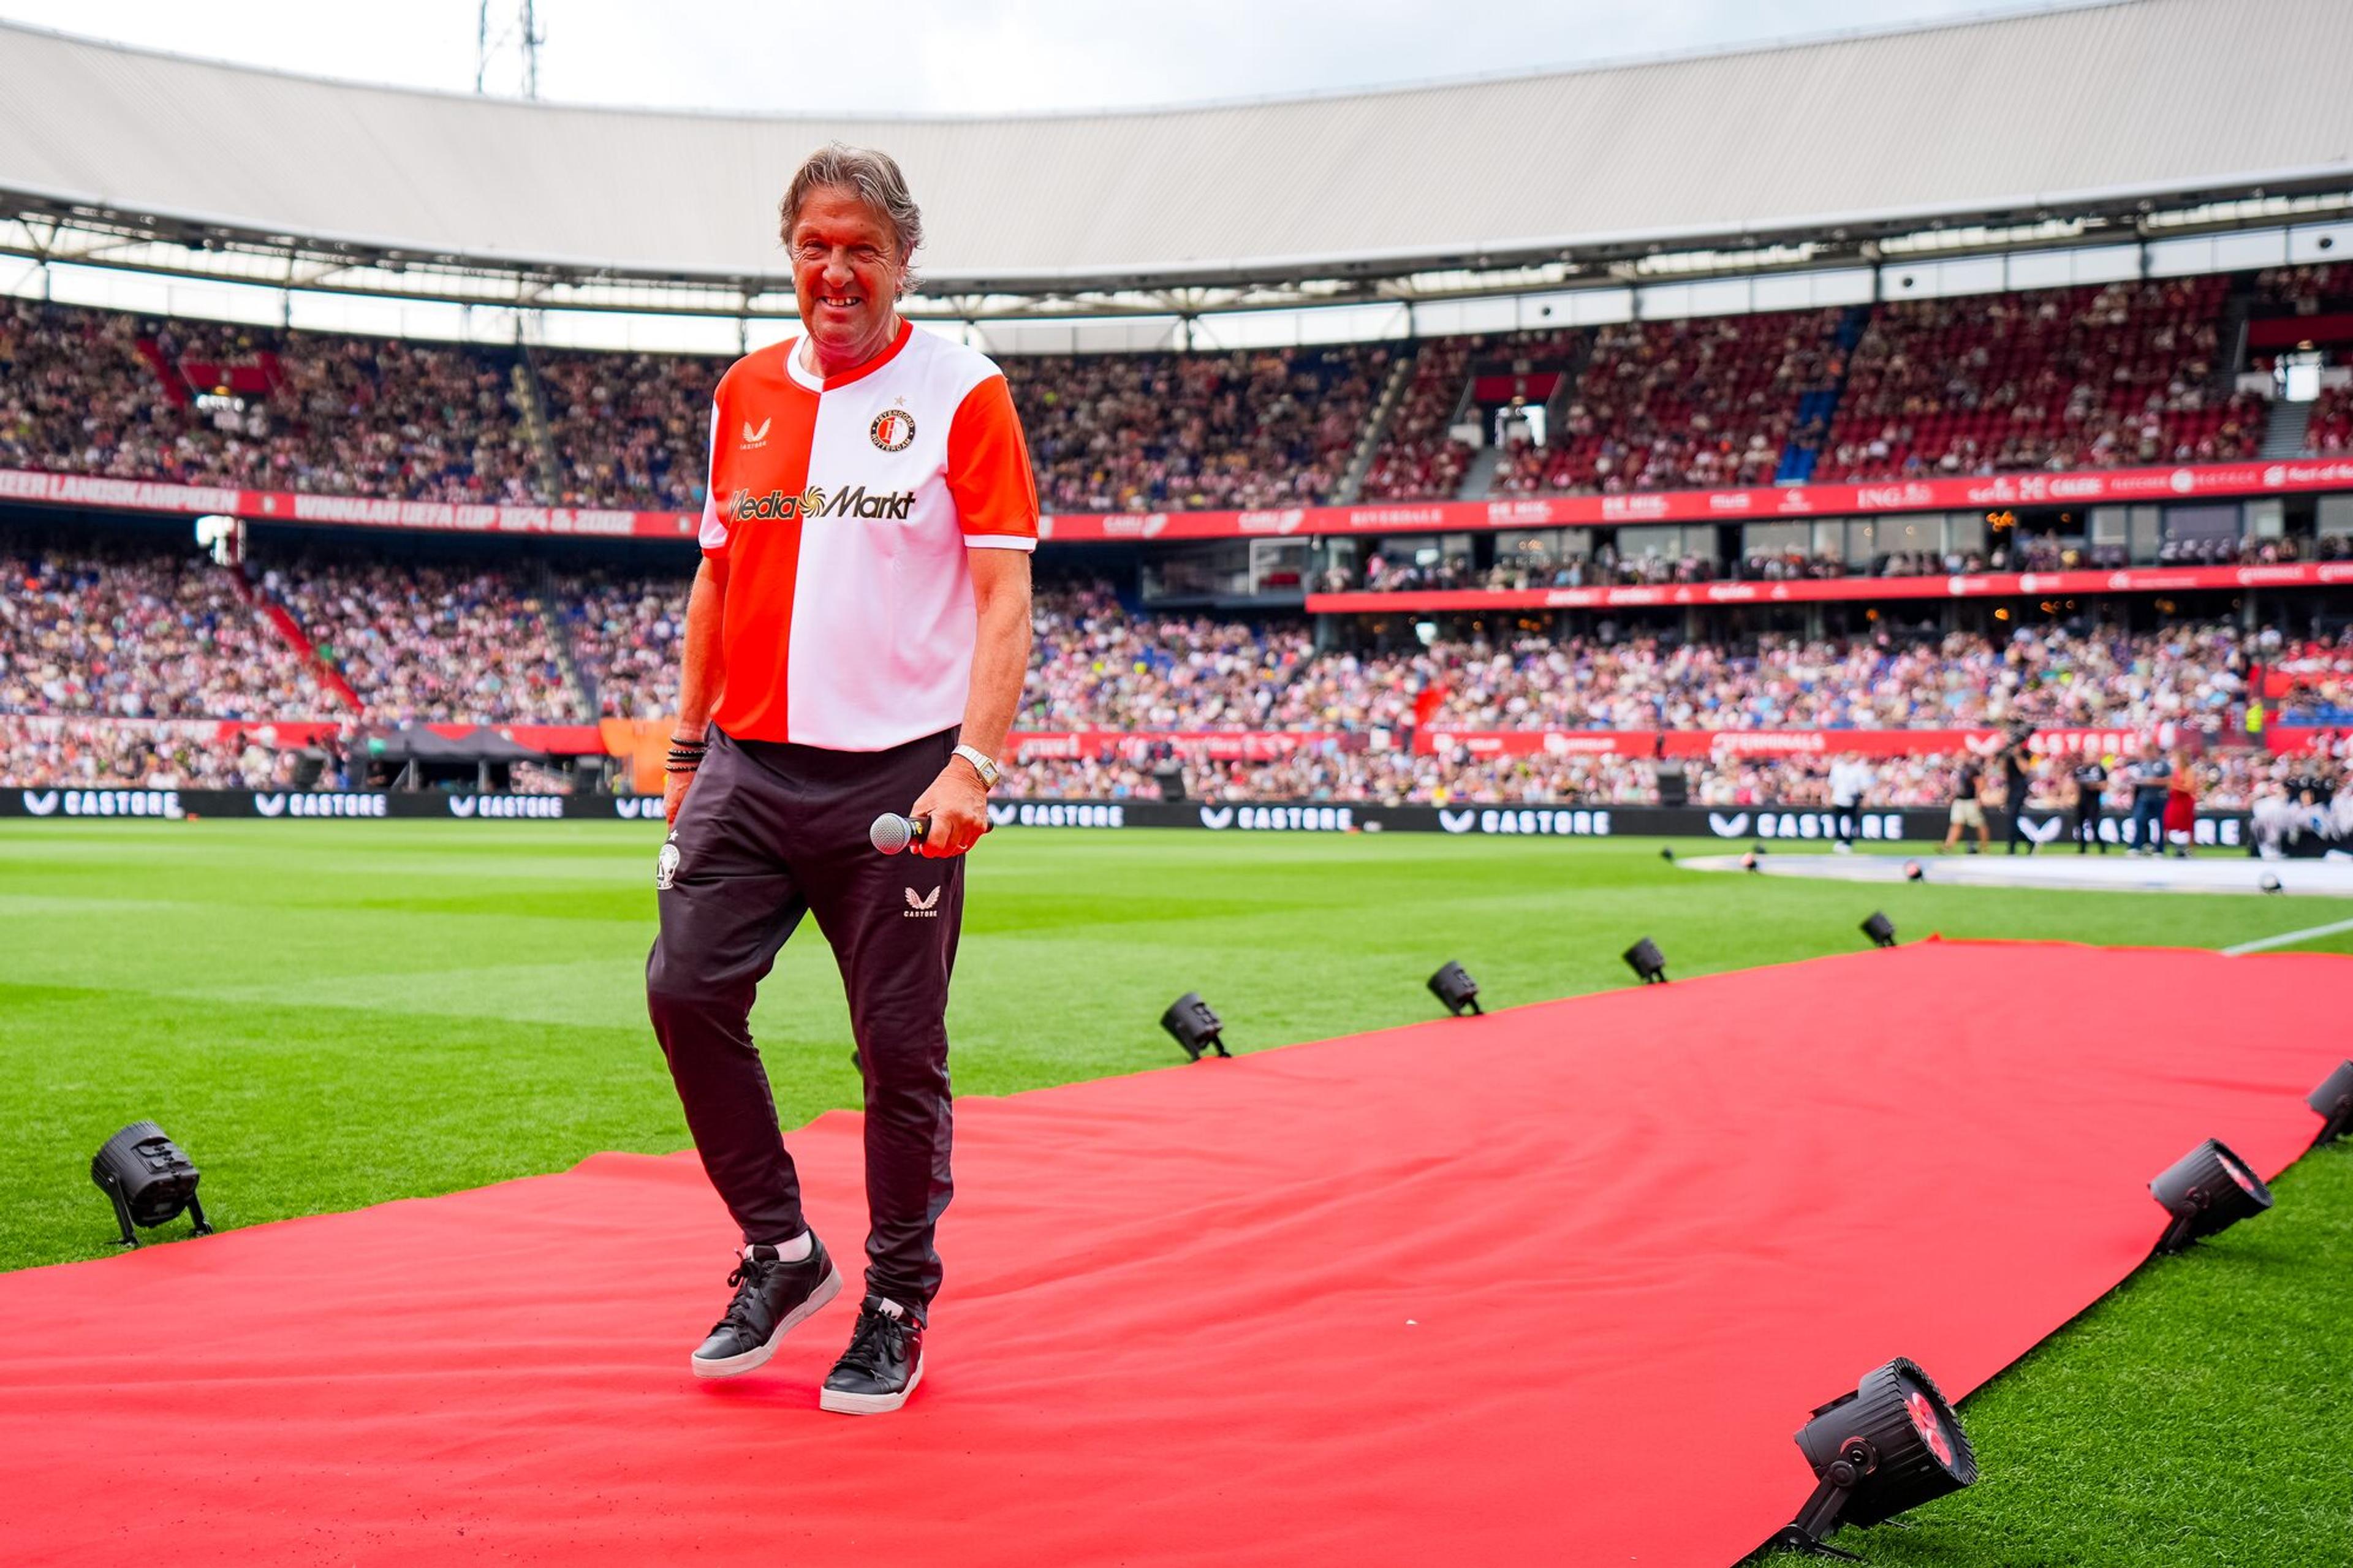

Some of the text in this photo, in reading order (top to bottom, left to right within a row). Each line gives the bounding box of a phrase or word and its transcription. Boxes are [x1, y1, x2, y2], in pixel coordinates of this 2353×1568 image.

[727, 485, 916, 520] Media Markt
[2027, 733, 2138, 754] ASTORE
[64, 791, 182, 816] CASTORE
[289, 794, 387, 817] CASTORE
[479, 796, 563, 817] CASTORE
[1020, 805, 1124, 827] CASTORE
[1237, 808, 1352, 831] CASTORE
[1480, 810, 1610, 835] CASTORE
